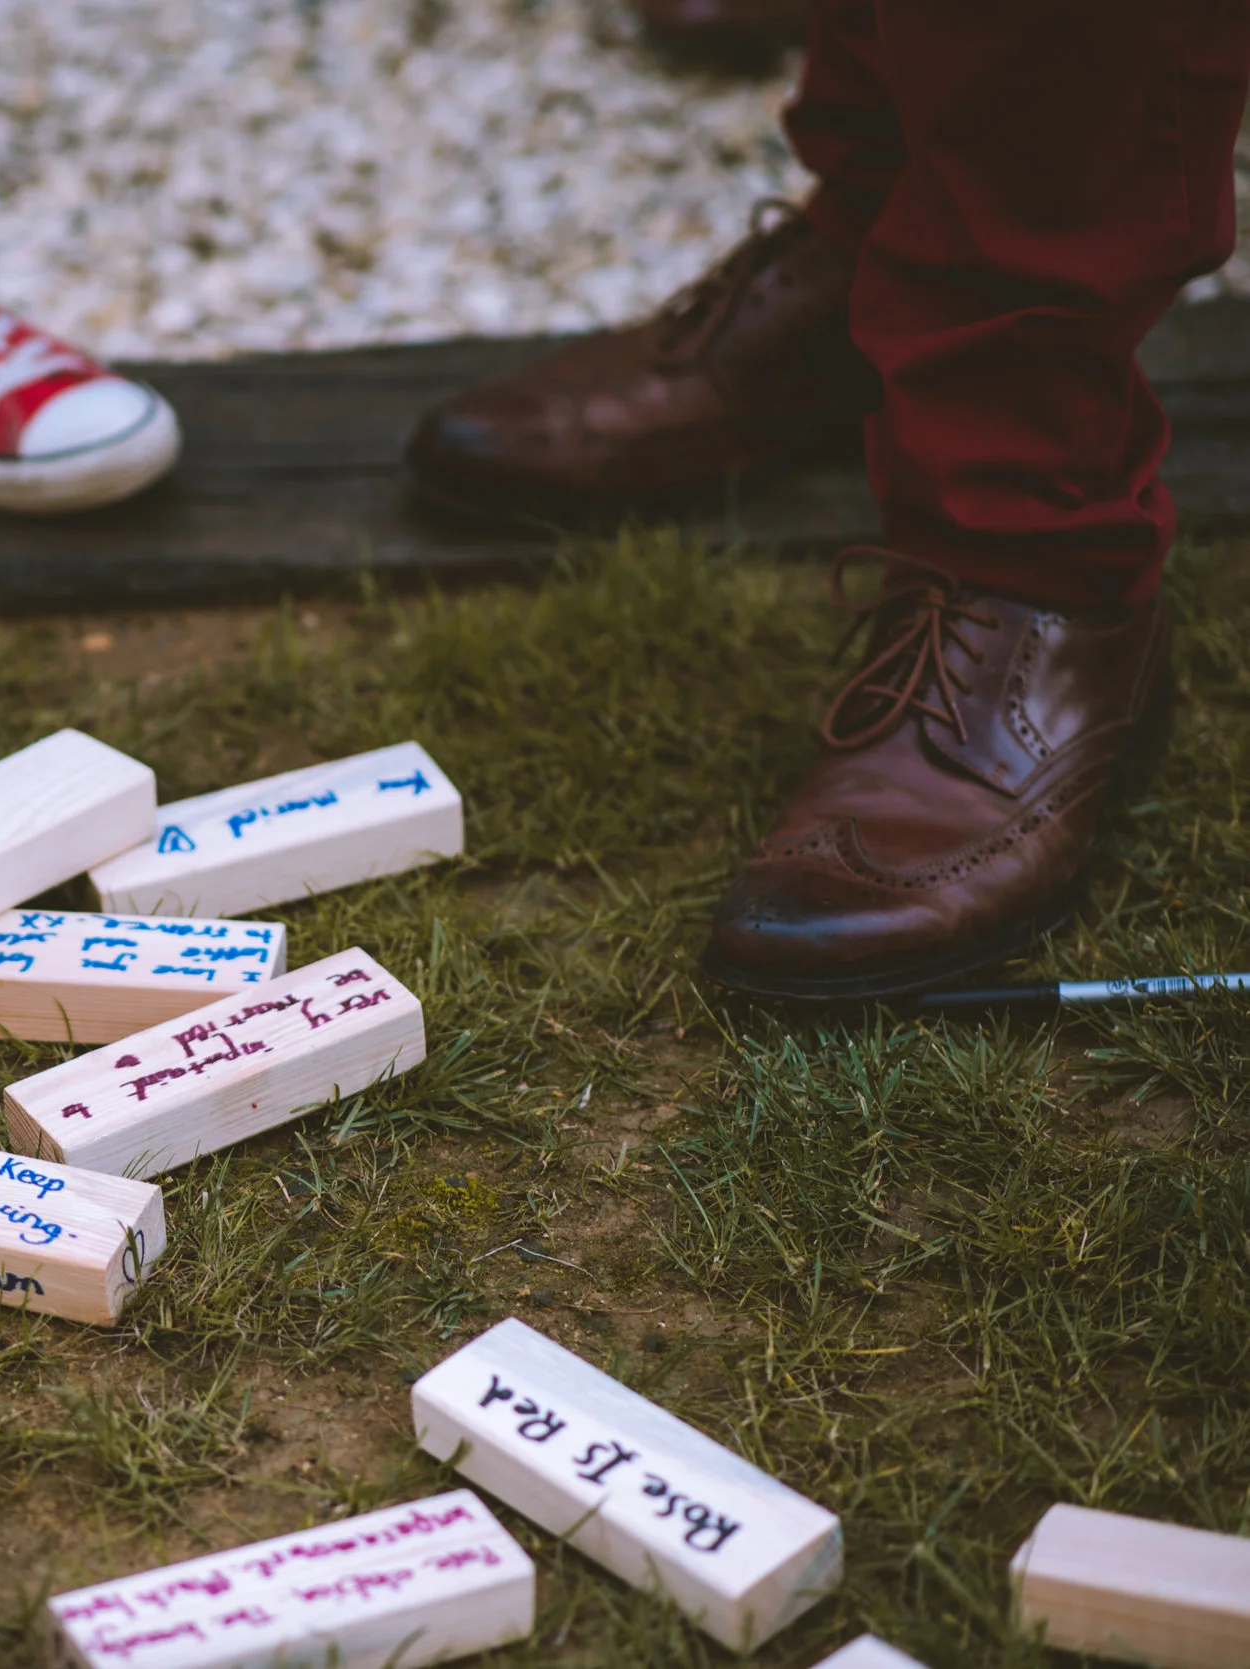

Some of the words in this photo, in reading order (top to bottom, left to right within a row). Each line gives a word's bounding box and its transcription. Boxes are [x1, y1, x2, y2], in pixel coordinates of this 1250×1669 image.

[80, 953, 138, 971] you
[326, 969, 372, 987] be
[299, 988, 391, 1029] very
[478, 1375, 567, 1443] Red
[572, 1440, 638, 1487] Is
[642, 1472, 742, 1555] Rose
